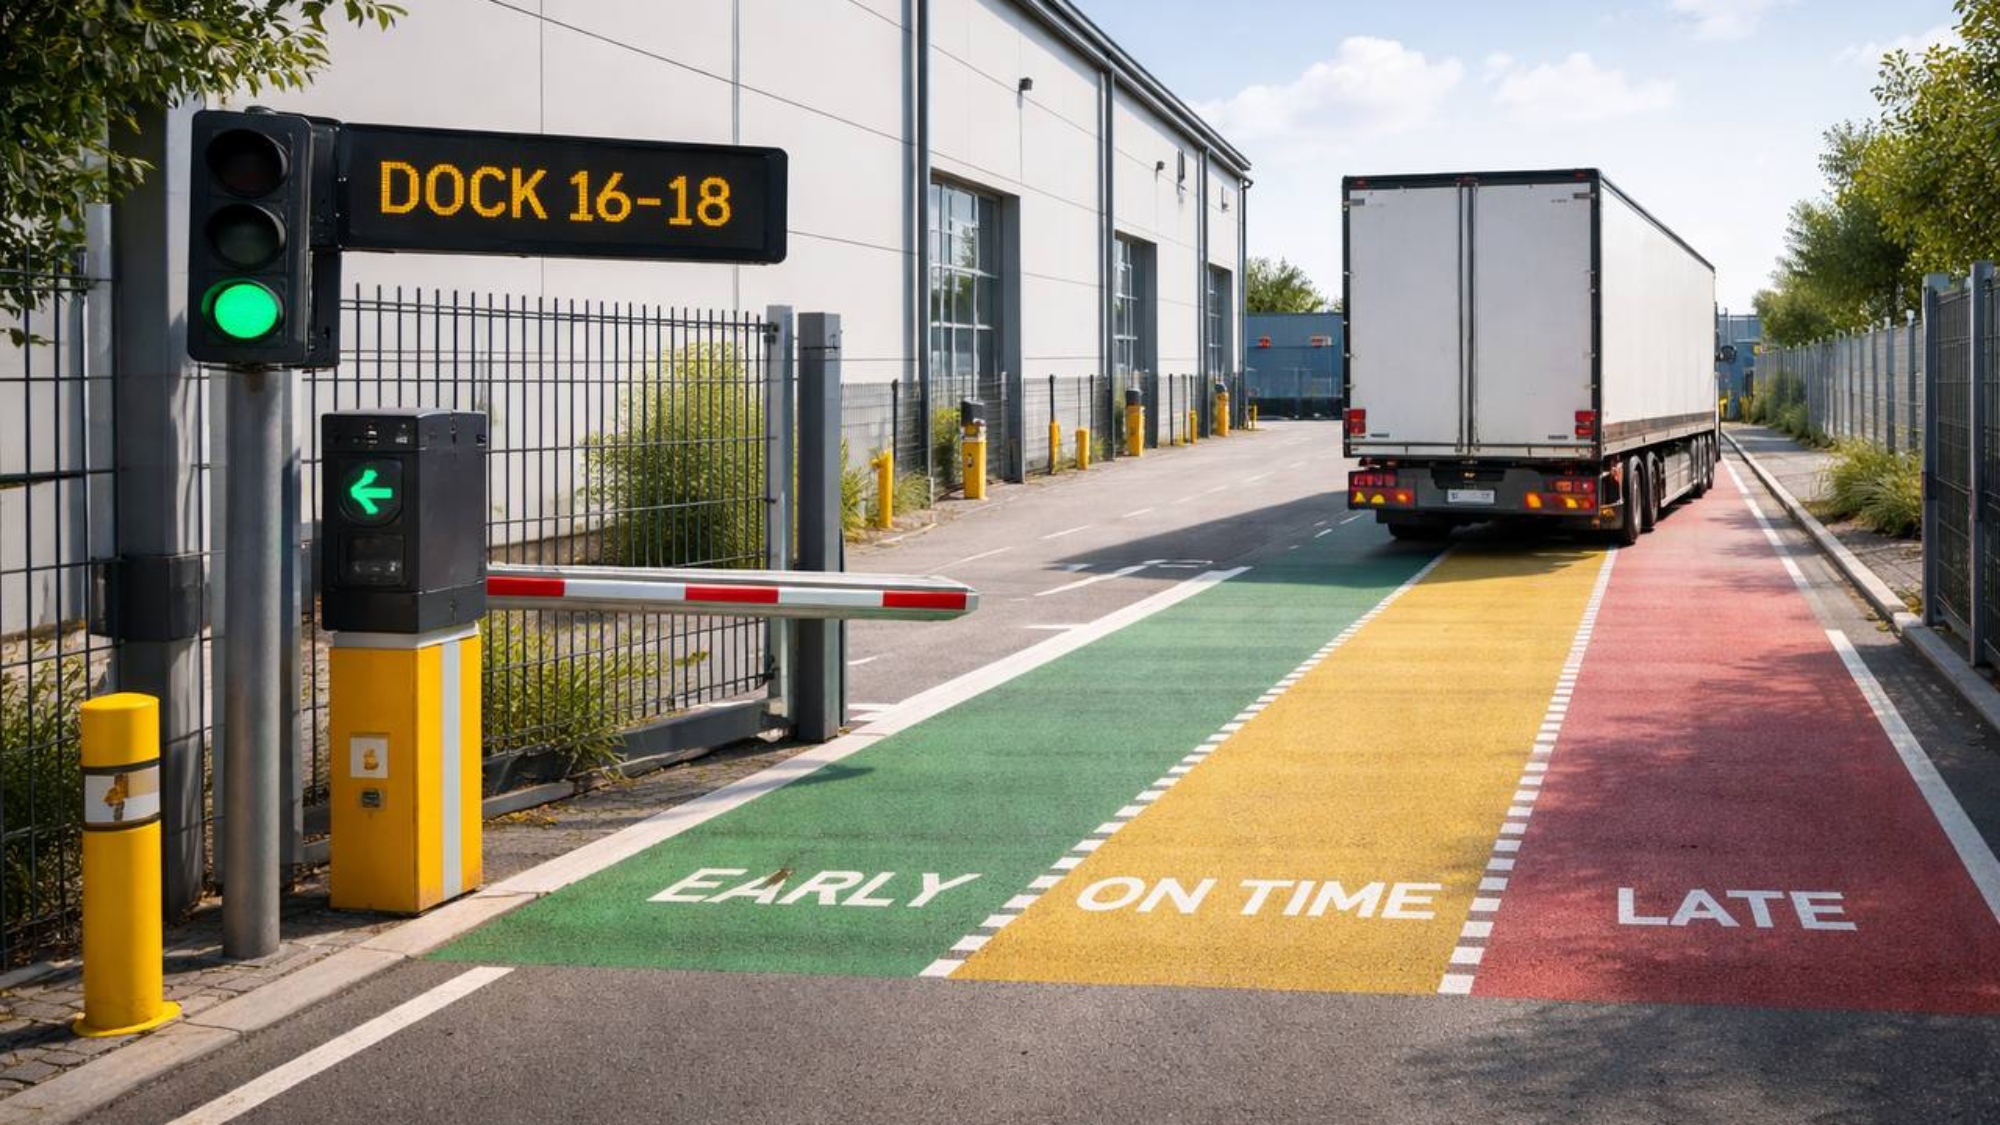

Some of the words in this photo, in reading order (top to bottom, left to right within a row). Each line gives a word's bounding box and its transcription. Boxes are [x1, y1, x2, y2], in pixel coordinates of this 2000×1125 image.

[379, 161, 547, 219] DOCK
[569, 171, 732, 228] 16-18
[646, 867, 983, 909] EARLY
[1075, 875, 1219, 916] ON
[1239, 878, 1443, 920] TIME
[1616, 887, 1857, 930] LATE
